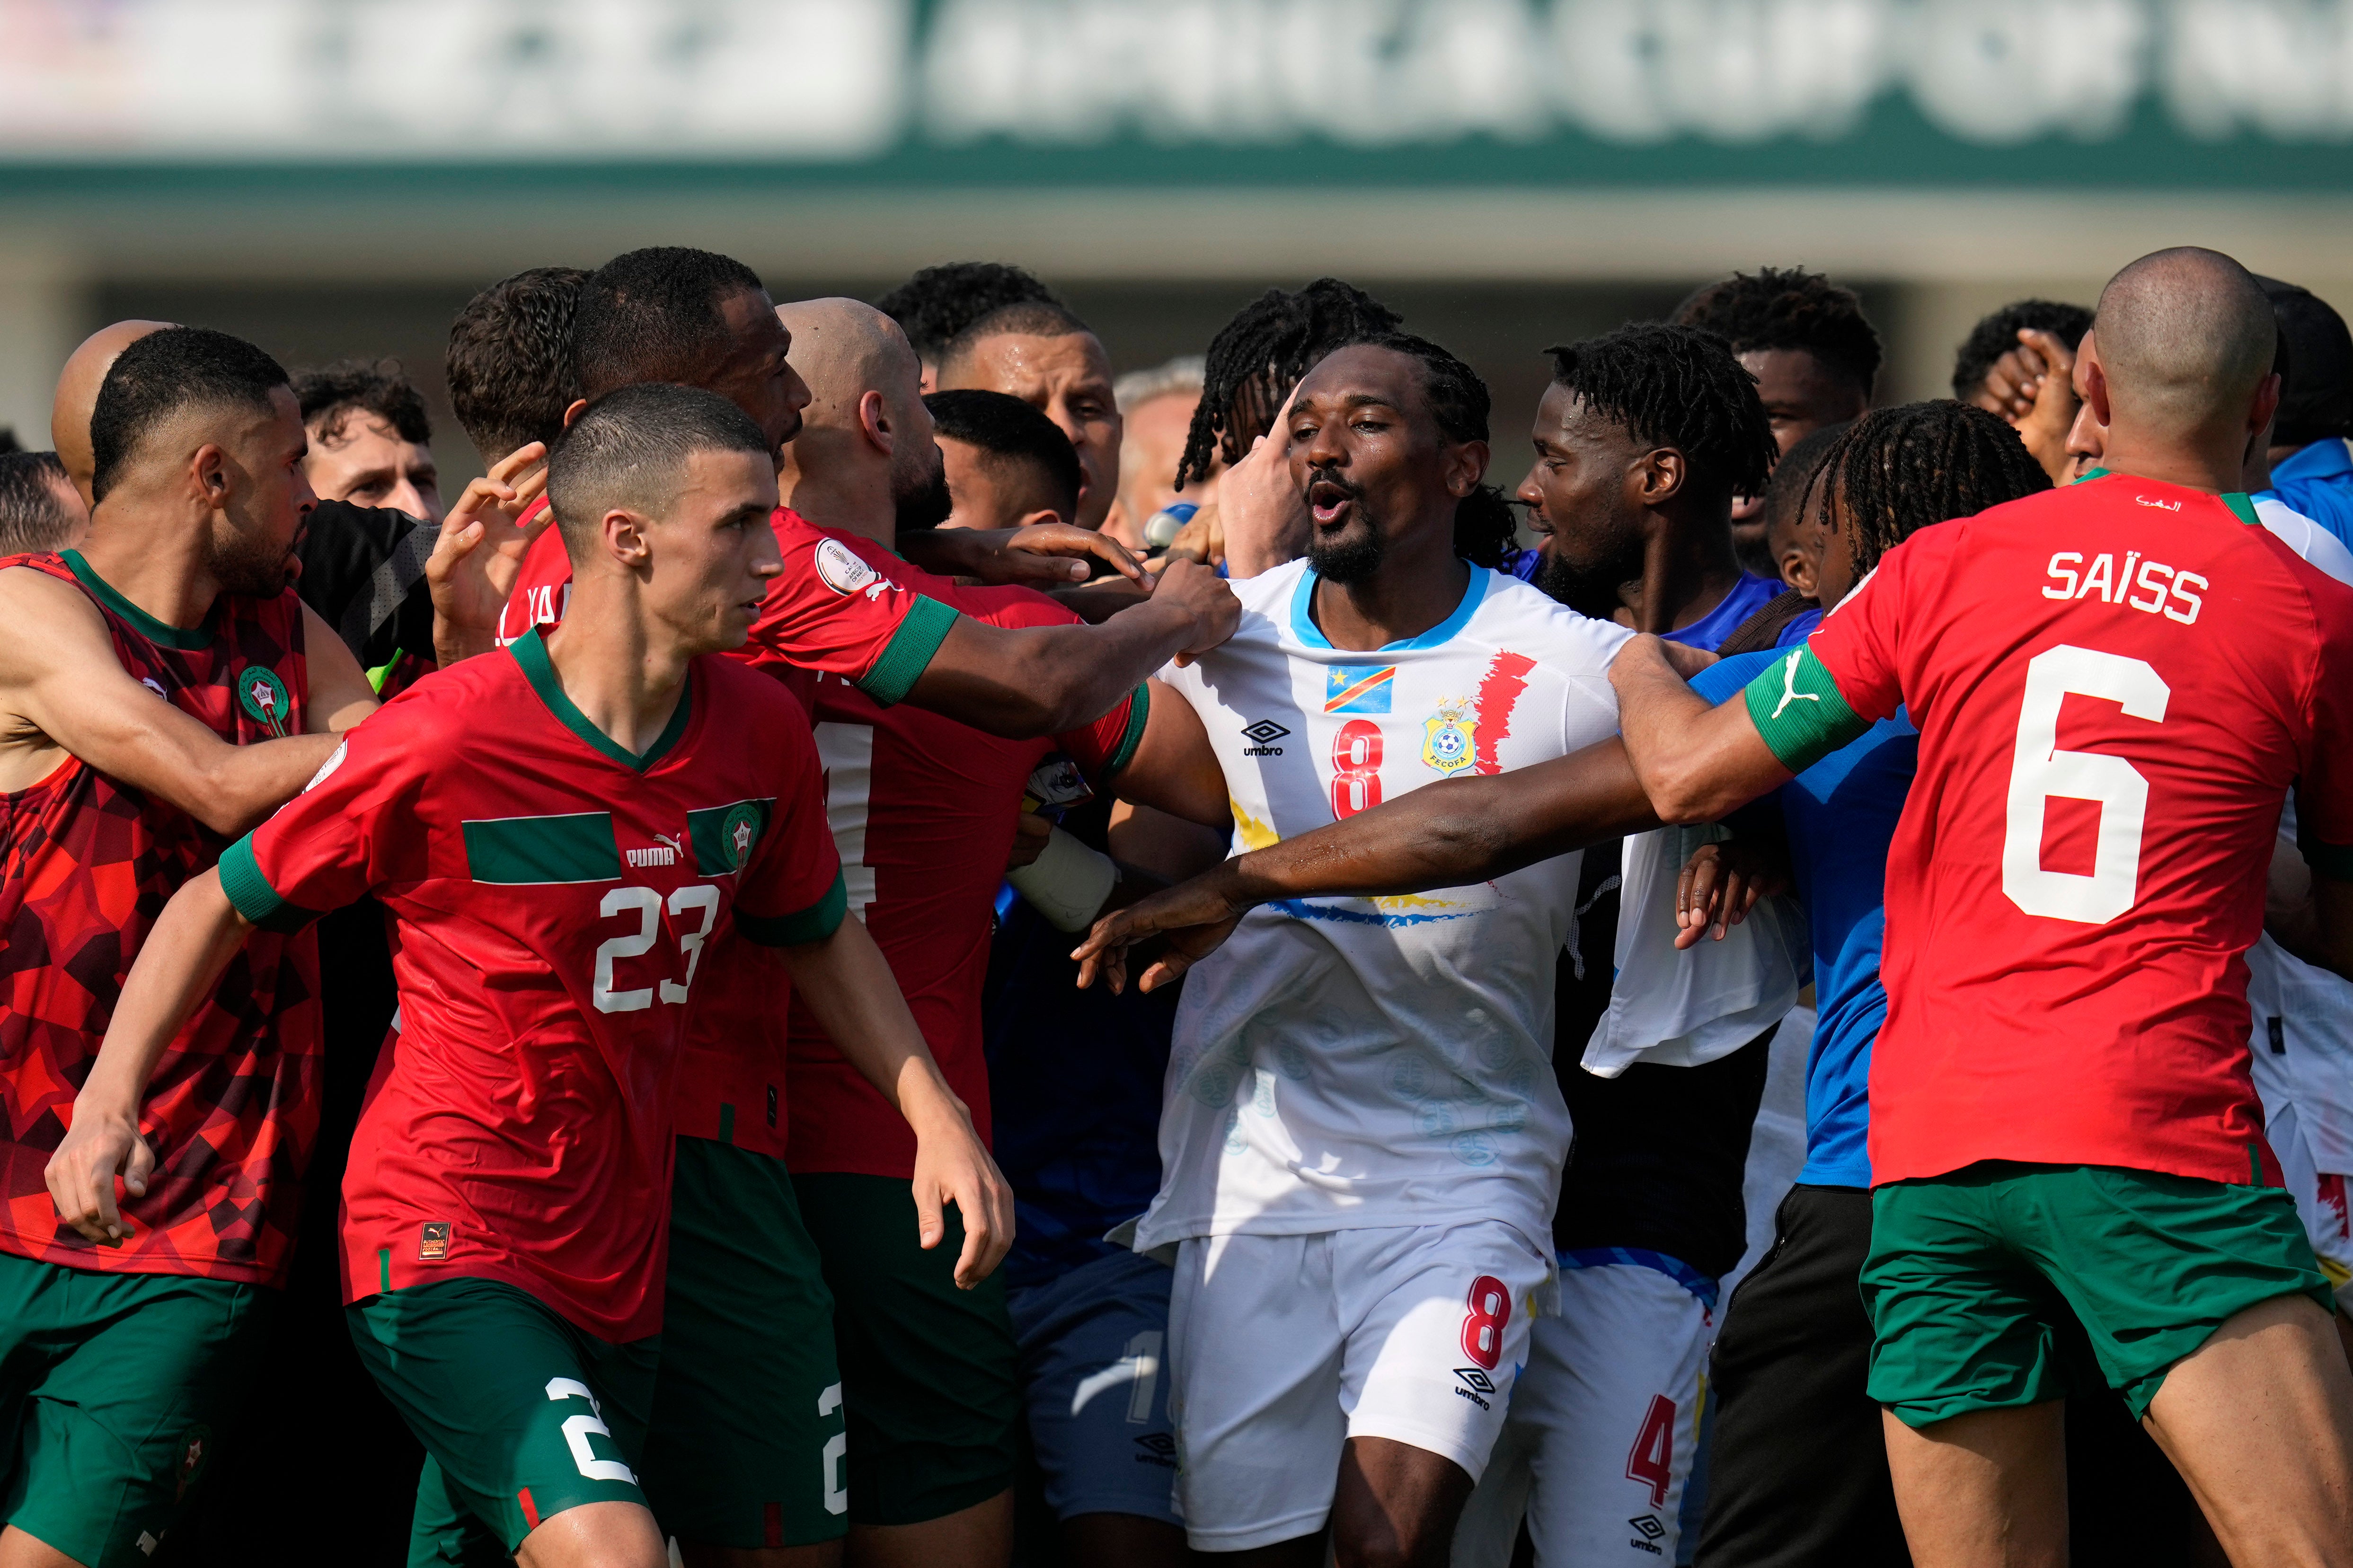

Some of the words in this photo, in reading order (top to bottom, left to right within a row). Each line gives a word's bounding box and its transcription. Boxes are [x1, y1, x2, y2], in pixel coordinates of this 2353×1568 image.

[2042, 550, 2209, 626] SAÏSS
[1243, 745, 1283, 758] umbro
[1331, 719, 1384, 821] 8
[1429, 755, 1467, 767] FECOFA
[2001, 643, 2171, 925] 6
[626, 847, 675, 868] PUMA
[593, 884, 721, 1014] 23
[1460, 1275, 1512, 1371] 8
[1454, 1386, 1490, 1411] umbro
[1626, 1393, 1677, 1511] 4
[1630, 1538, 1663, 1556] umbro
